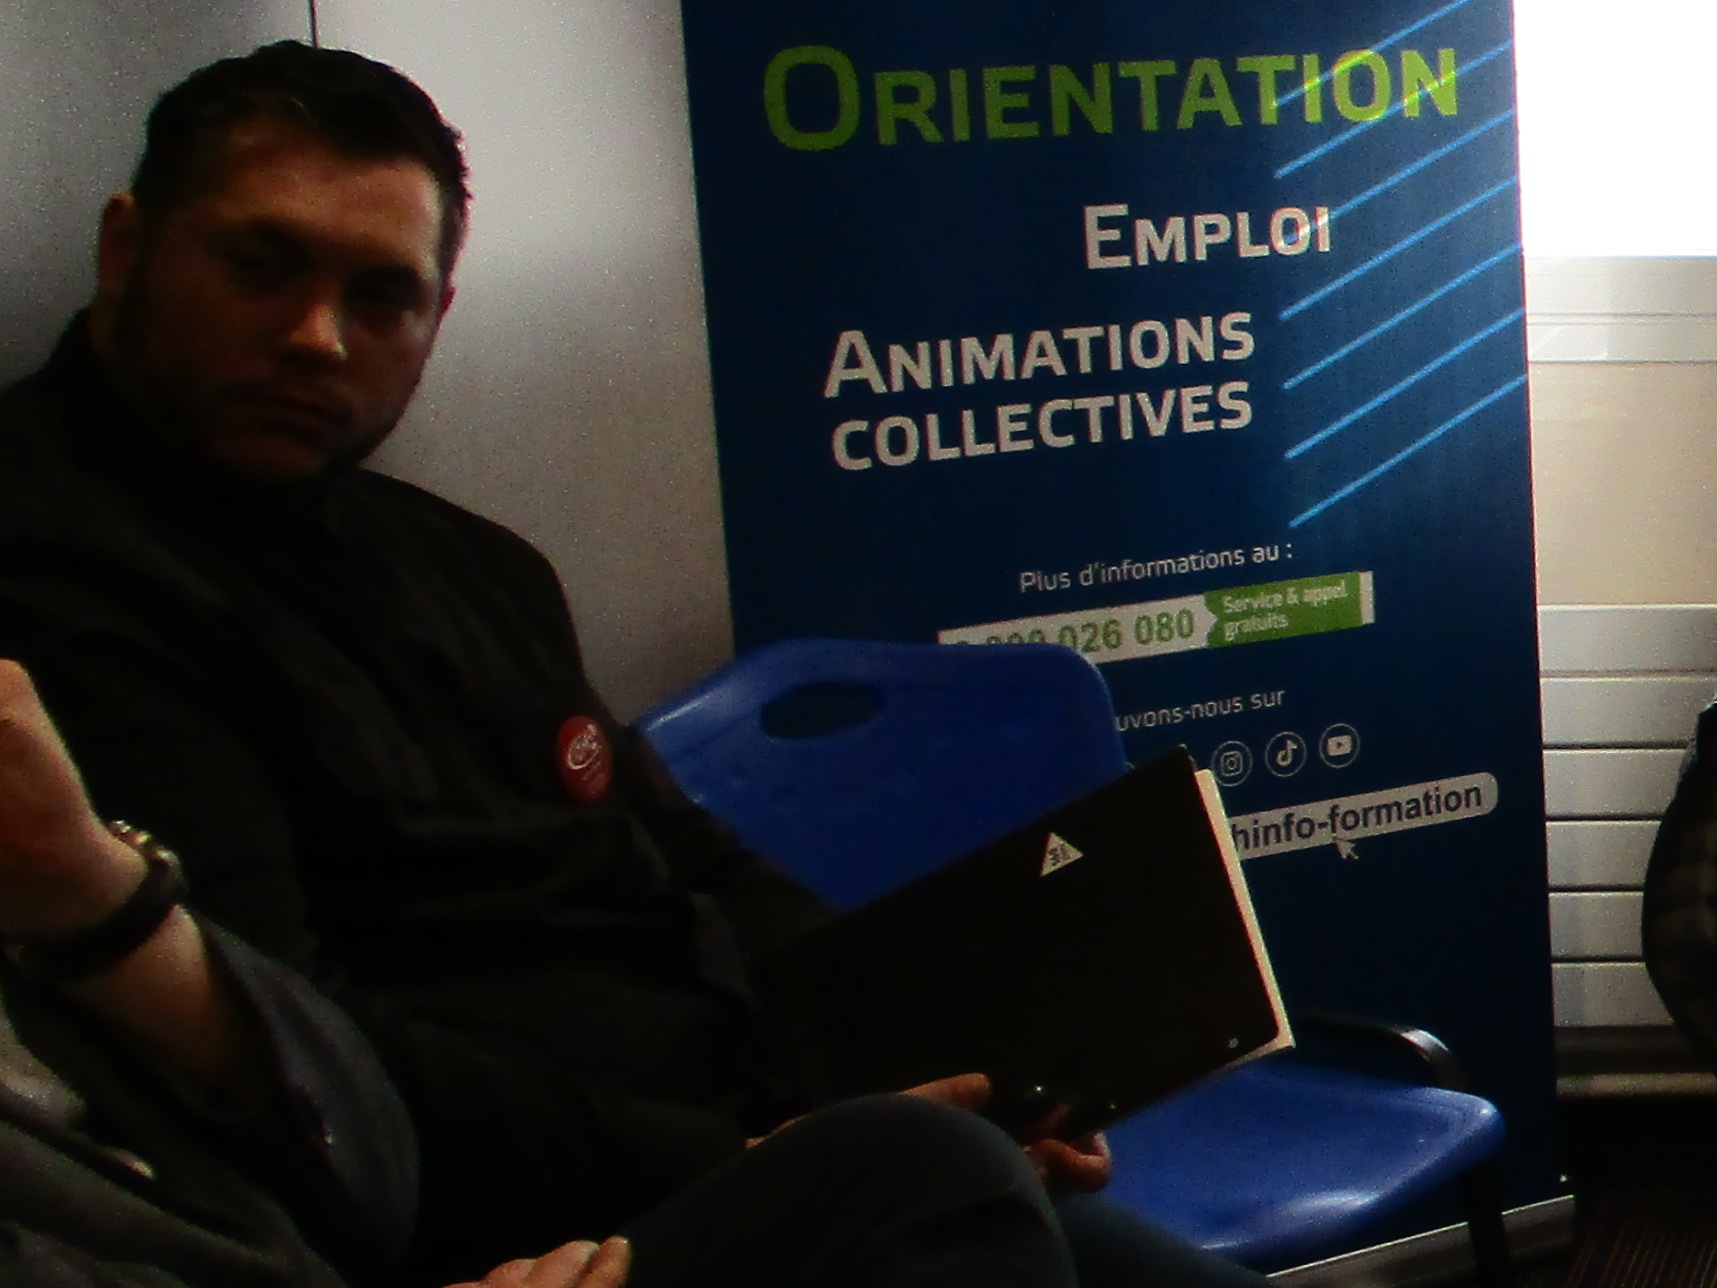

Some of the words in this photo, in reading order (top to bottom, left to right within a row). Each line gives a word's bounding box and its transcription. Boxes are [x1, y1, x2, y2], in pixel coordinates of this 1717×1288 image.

[762, 44, 1459, 152] ORIENTATION
[1084, 203, 1331, 270] EMPLOI
[823, 311, 1255, 399] ANIMATIONS
[832, 381, 1253, 471] COLLECTIVES
[1019, 570, 1071, 594] Plus
[1079, 549, 1245, 588] d'informations
[1252, 544, 1280, 564] au
[1222, 591, 1283, 614] Service
[1286, 586, 1300, 605] &
[1303, 579, 1348, 607] appel
[1134, 608, 1195, 646] 080
[1223, 613, 1290, 642] gratuits
[1250, 690, 1287, 710] sur
